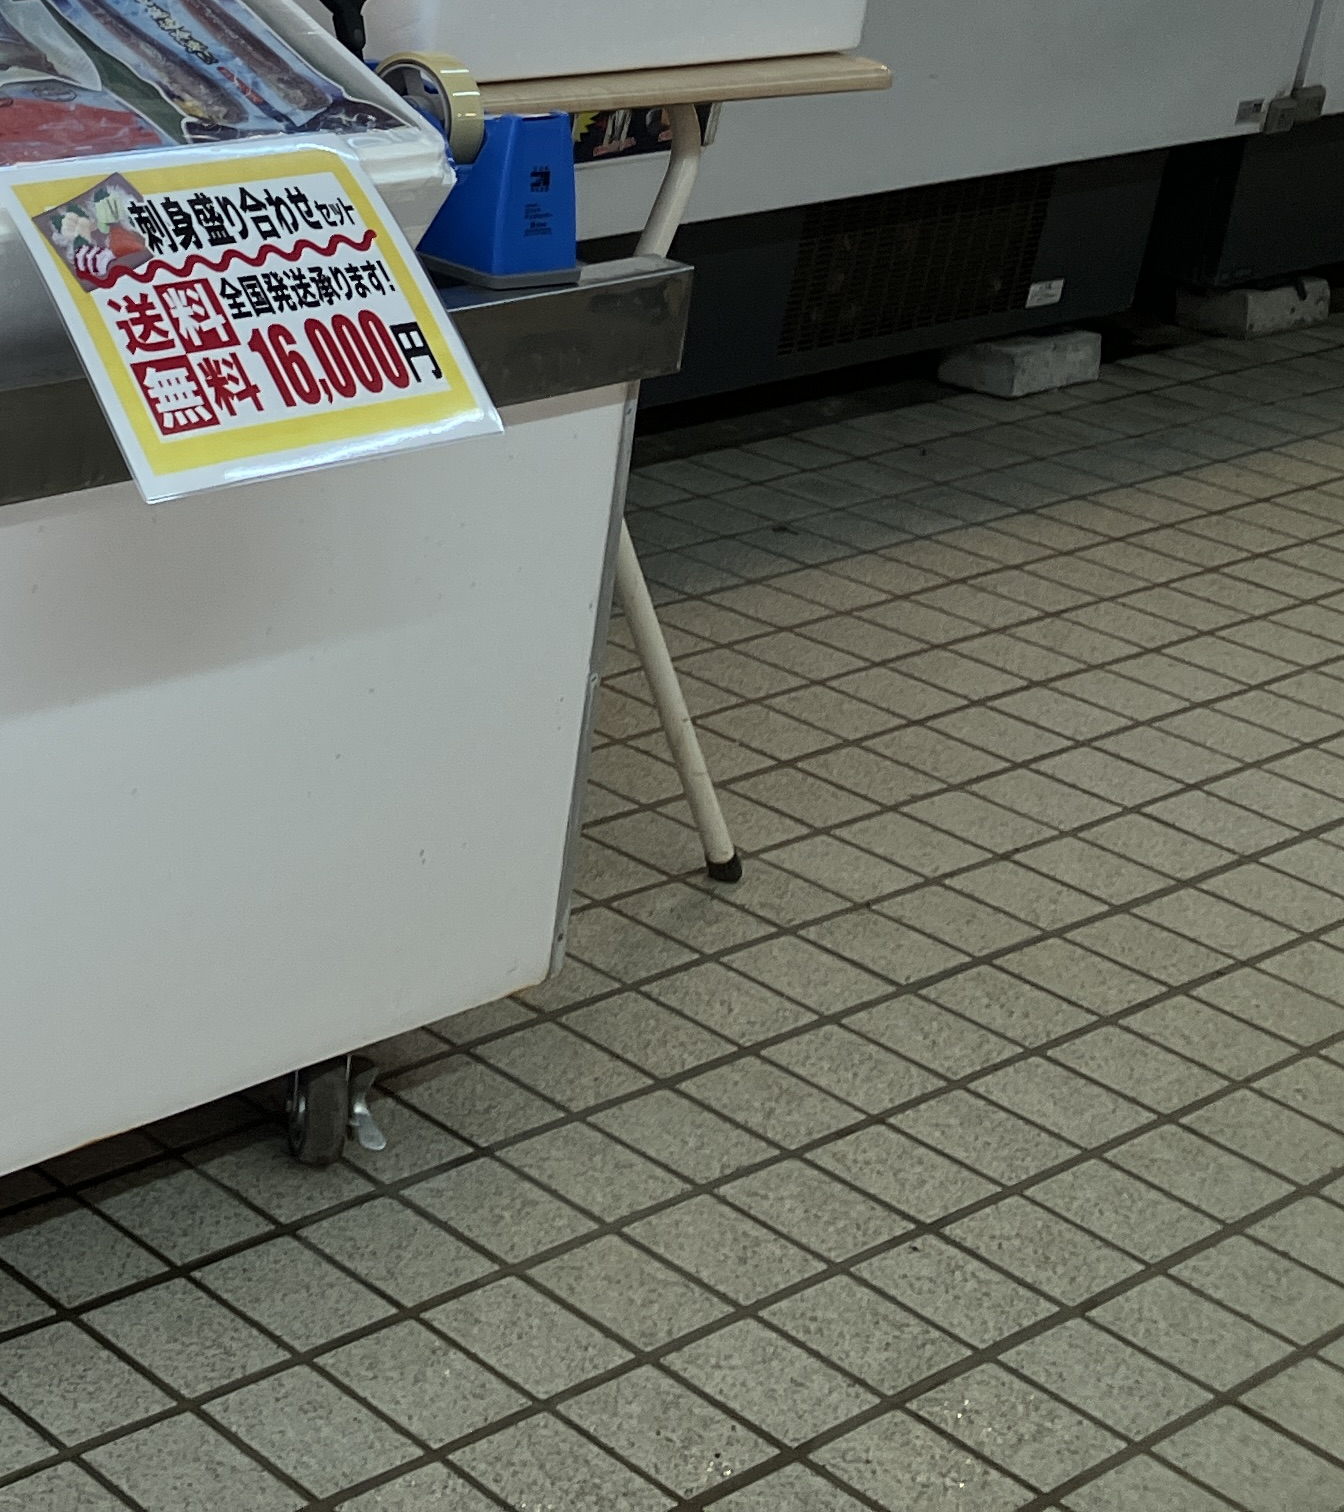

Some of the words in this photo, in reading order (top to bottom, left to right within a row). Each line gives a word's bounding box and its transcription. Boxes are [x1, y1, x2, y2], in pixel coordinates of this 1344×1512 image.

[128, 184, 358, 252] 刺身盛り合わせセット
[109, 281, 232, 354] 送料
[218, 260, 393, 320] 全国発送承ります!
[142, 352, 260, 434] 無料
[249, 307, 444, 412] 16,000円
